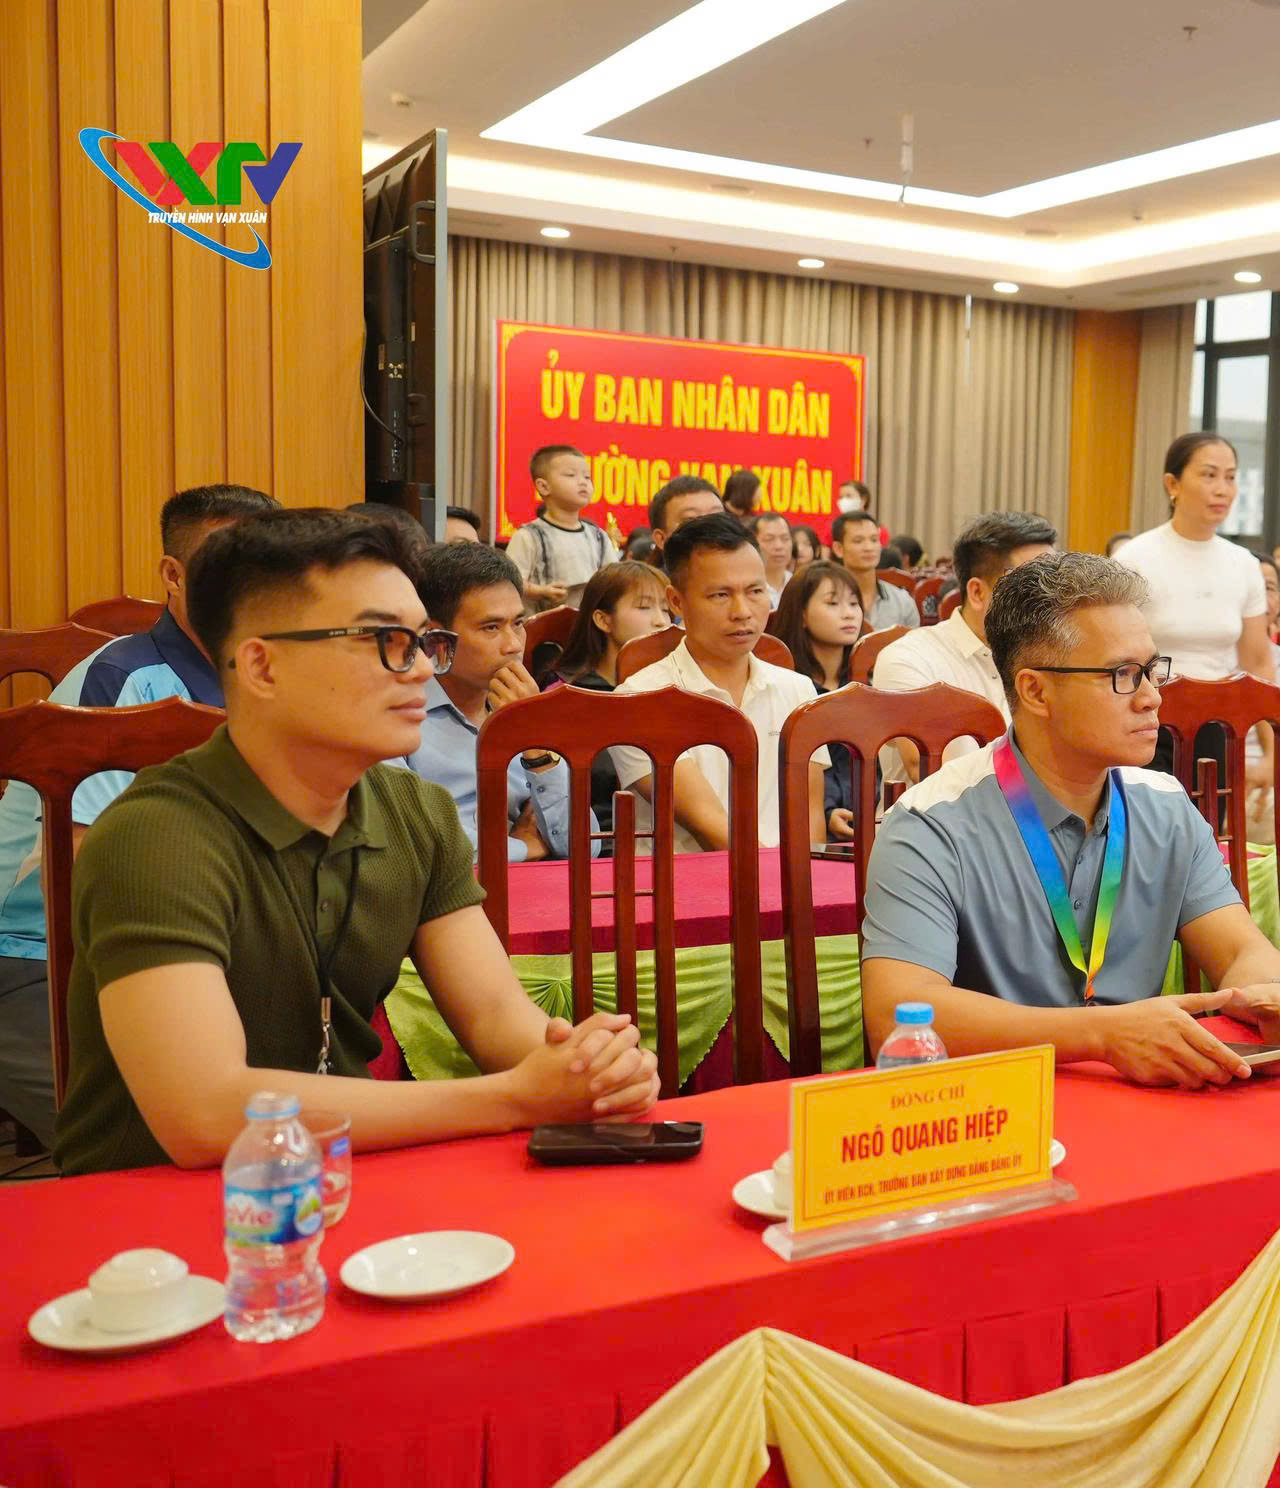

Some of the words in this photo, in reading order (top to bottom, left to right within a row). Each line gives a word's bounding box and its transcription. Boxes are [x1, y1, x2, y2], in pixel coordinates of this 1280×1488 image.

[541, 349, 585, 421] ỦY
[595, 373, 662, 426] BAN
[671, 374, 760, 434] NHÂN
[767, 380, 830, 438] DÂN
[535, 441, 671, 507] ƯỜNG
[752, 457, 833, 515] XUÂN
[890, 1087, 934, 1110] ĐỒNG
[938, 1083, 966, 1101] CHÍ
[841, 1125, 883, 1163] NGÔ
[892, 1116, 958, 1156] QUANG
[965, 1105, 1009, 1143] HIỆP
